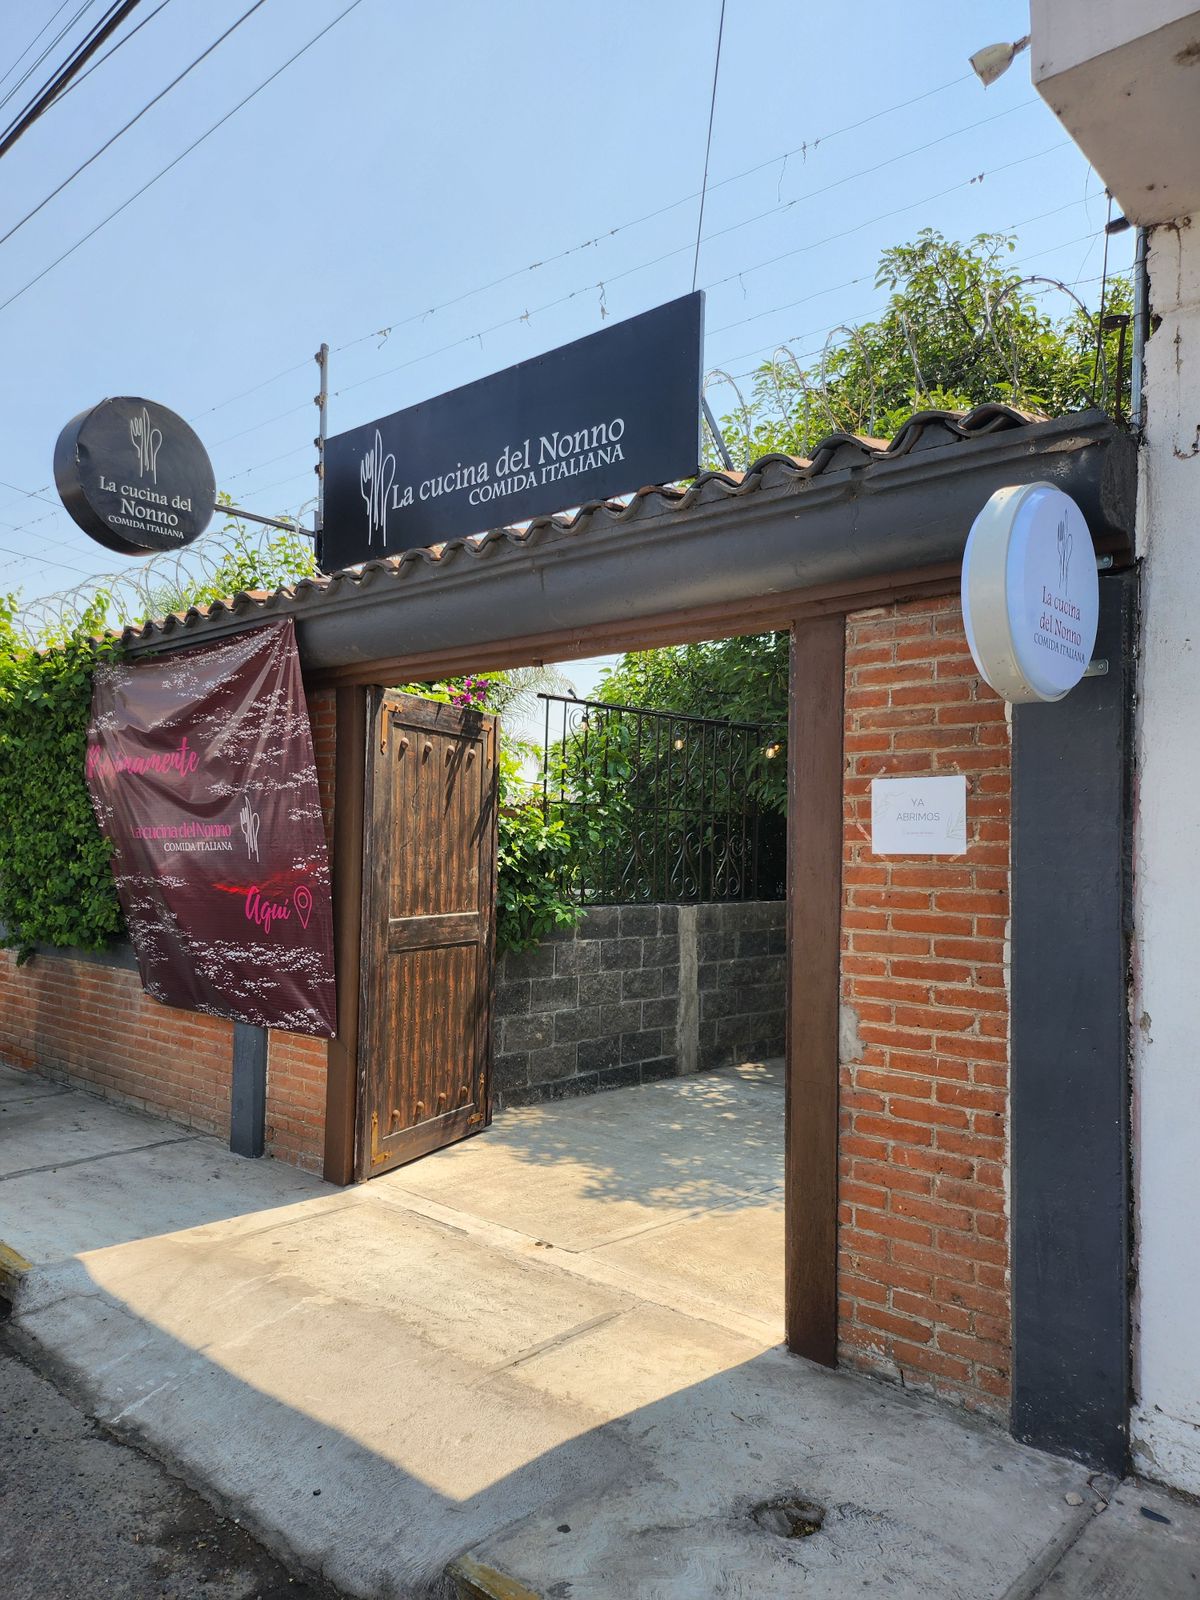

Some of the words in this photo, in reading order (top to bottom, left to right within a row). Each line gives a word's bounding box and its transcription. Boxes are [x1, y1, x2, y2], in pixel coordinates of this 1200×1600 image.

[392, 484, 414, 510] La
[419, 462, 489, 501] cucina
[495, 439, 530, 475] del
[538, 418, 625, 464] Nonno
[469, 471, 538, 506] COMIDA
[541, 444, 625, 483] ITALIANA
[100, 476, 117, 492] La
[121, 485, 168, 506] cucina
[171, 496, 192, 512] del
[108, 515, 145, 530] COMIDA
[146, 523, 185, 539] ITALIANA
[121, 498, 178, 526] Nonno
[1042, 586, 1052, 606] La
[1054, 597, 1080, 620] cucina
[1040, 612, 1053, 633] del
[1055, 619, 1081, 646] Nonno
[1034, 633, 1059, 652] COMIDA
[1060, 644, 1085, 664] ITALIANA
[896, 812, 940, 822] ABRIMOS
[911, 798, 925, 807] YA
[142, 824, 178, 839] cucina
[180, 822, 195, 838] del
[196, 822, 232, 838] Nonno
[163, 843, 196, 852] COMIDA
[197, 842, 233, 851] ITALIANA
[245, 885, 291, 934] Aquí
